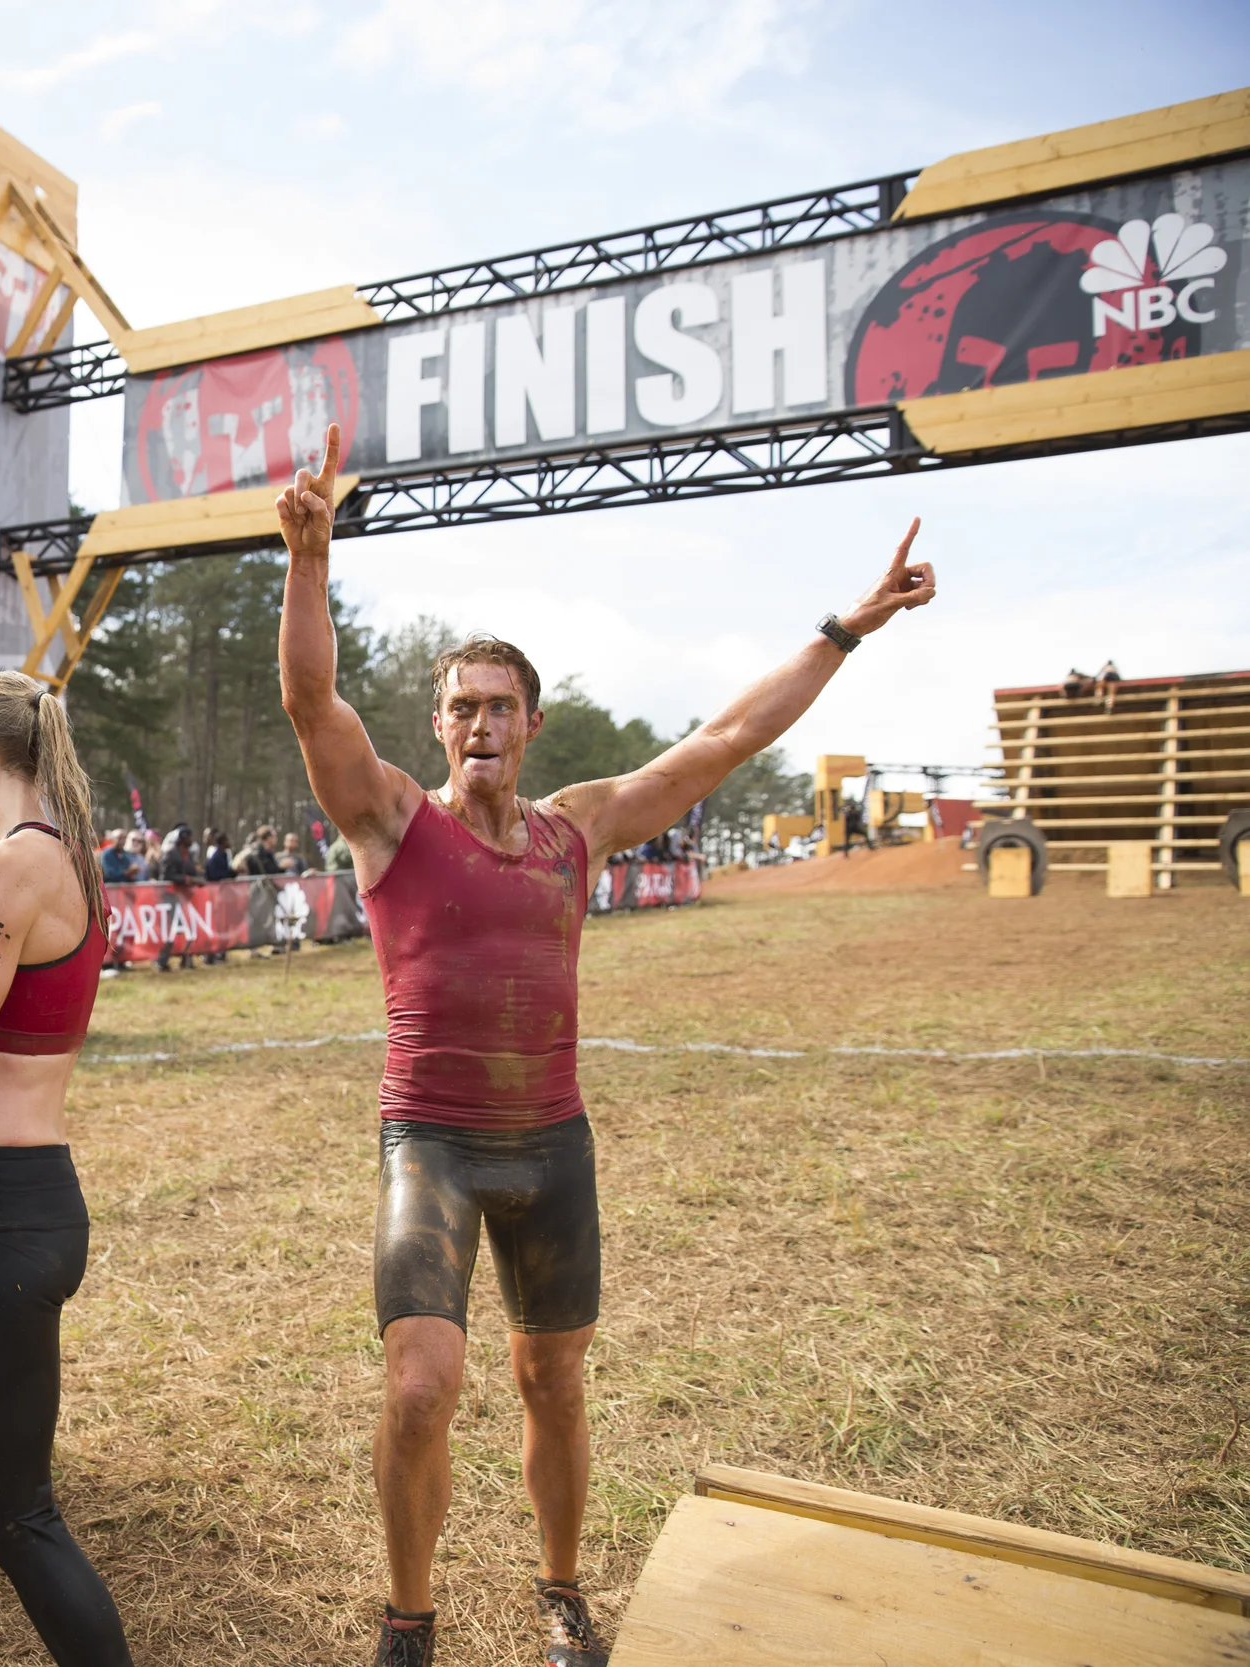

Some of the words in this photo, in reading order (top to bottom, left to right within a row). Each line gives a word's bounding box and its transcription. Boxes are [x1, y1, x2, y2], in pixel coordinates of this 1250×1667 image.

[1092, 278, 1215, 338] NBC
[386, 258, 828, 463] FINISH
[108, 900, 214, 946] PARTAN
